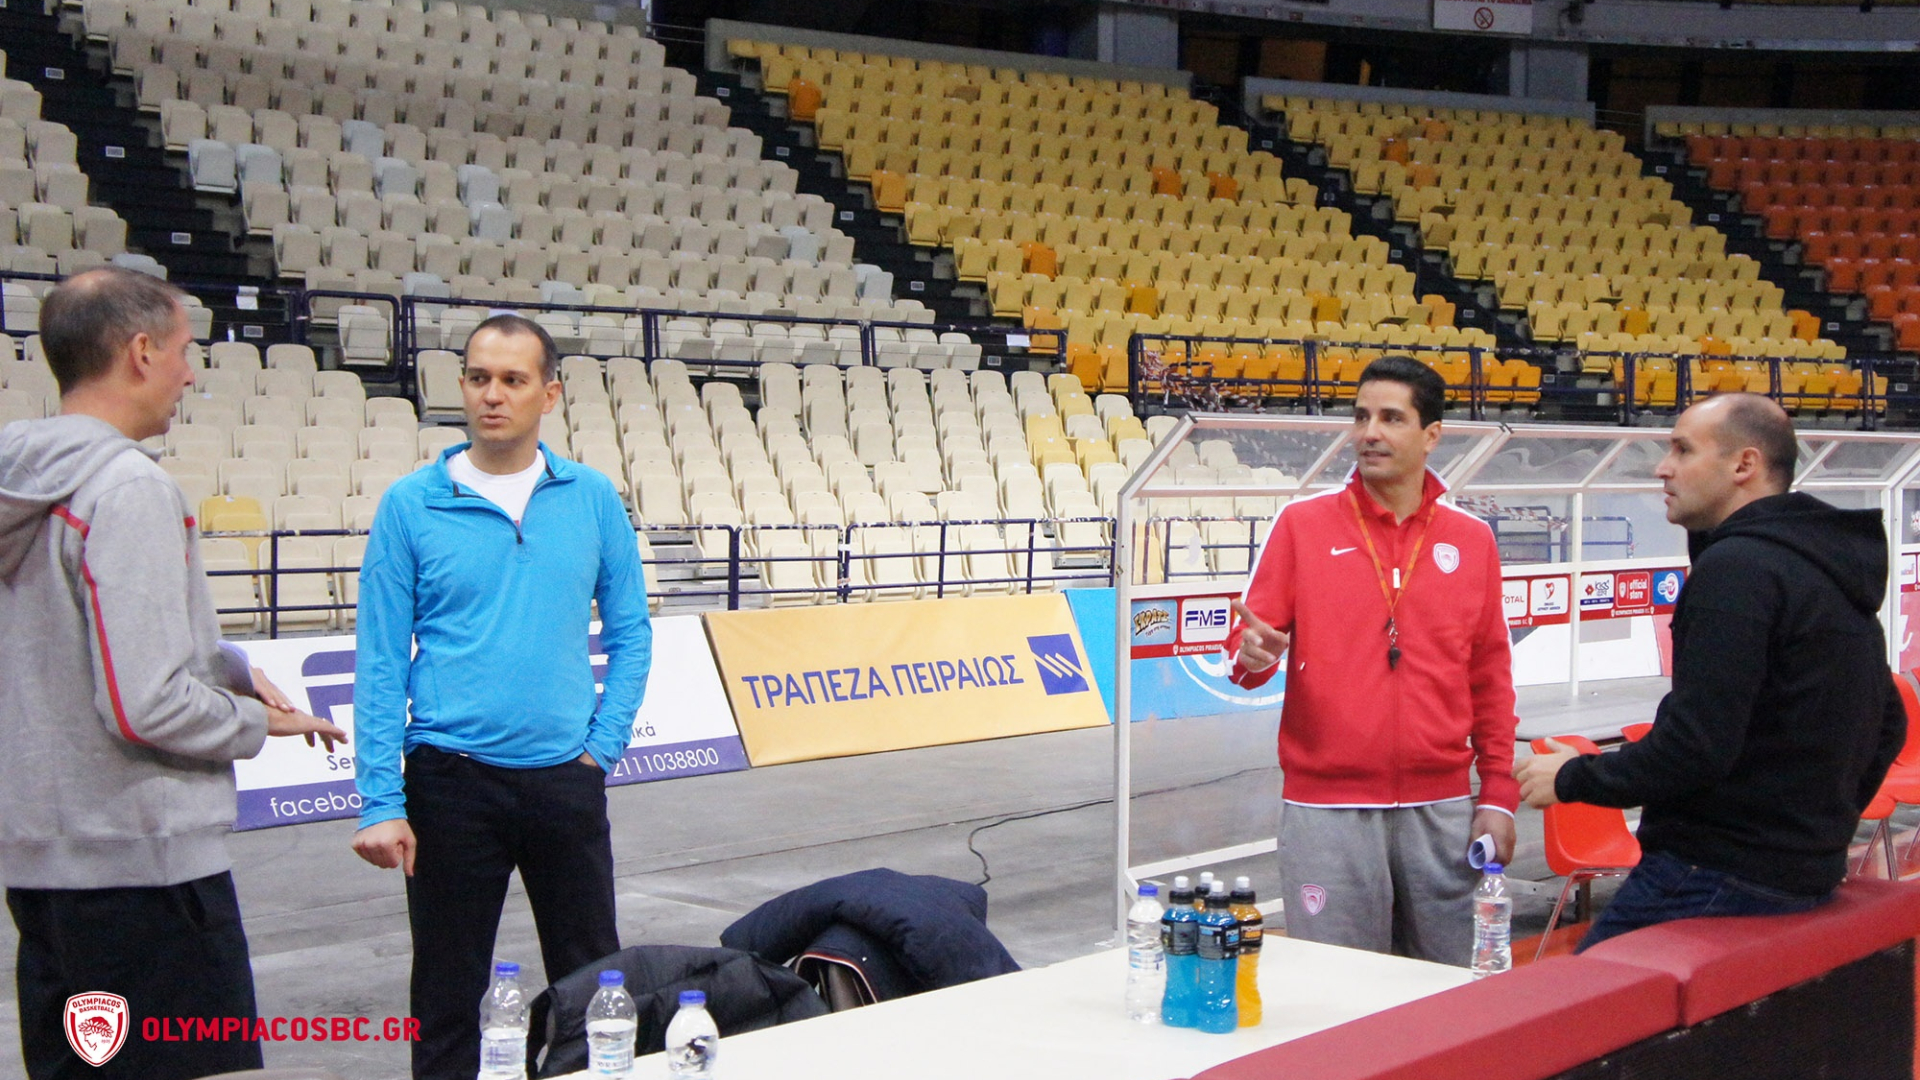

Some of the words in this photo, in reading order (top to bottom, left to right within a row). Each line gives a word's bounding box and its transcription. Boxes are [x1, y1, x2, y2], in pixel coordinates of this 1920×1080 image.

[1629, 579, 1648, 589] official
[1629, 590, 1644, 600] store
[1185, 609, 1227, 627] FMS
[742, 666, 891, 709] ΤΡΑΠΕΖΑ
[891, 654, 1025, 697] ΠΕΙΡΑΙΩΣ
[613, 747, 719, 777] 2111038800
